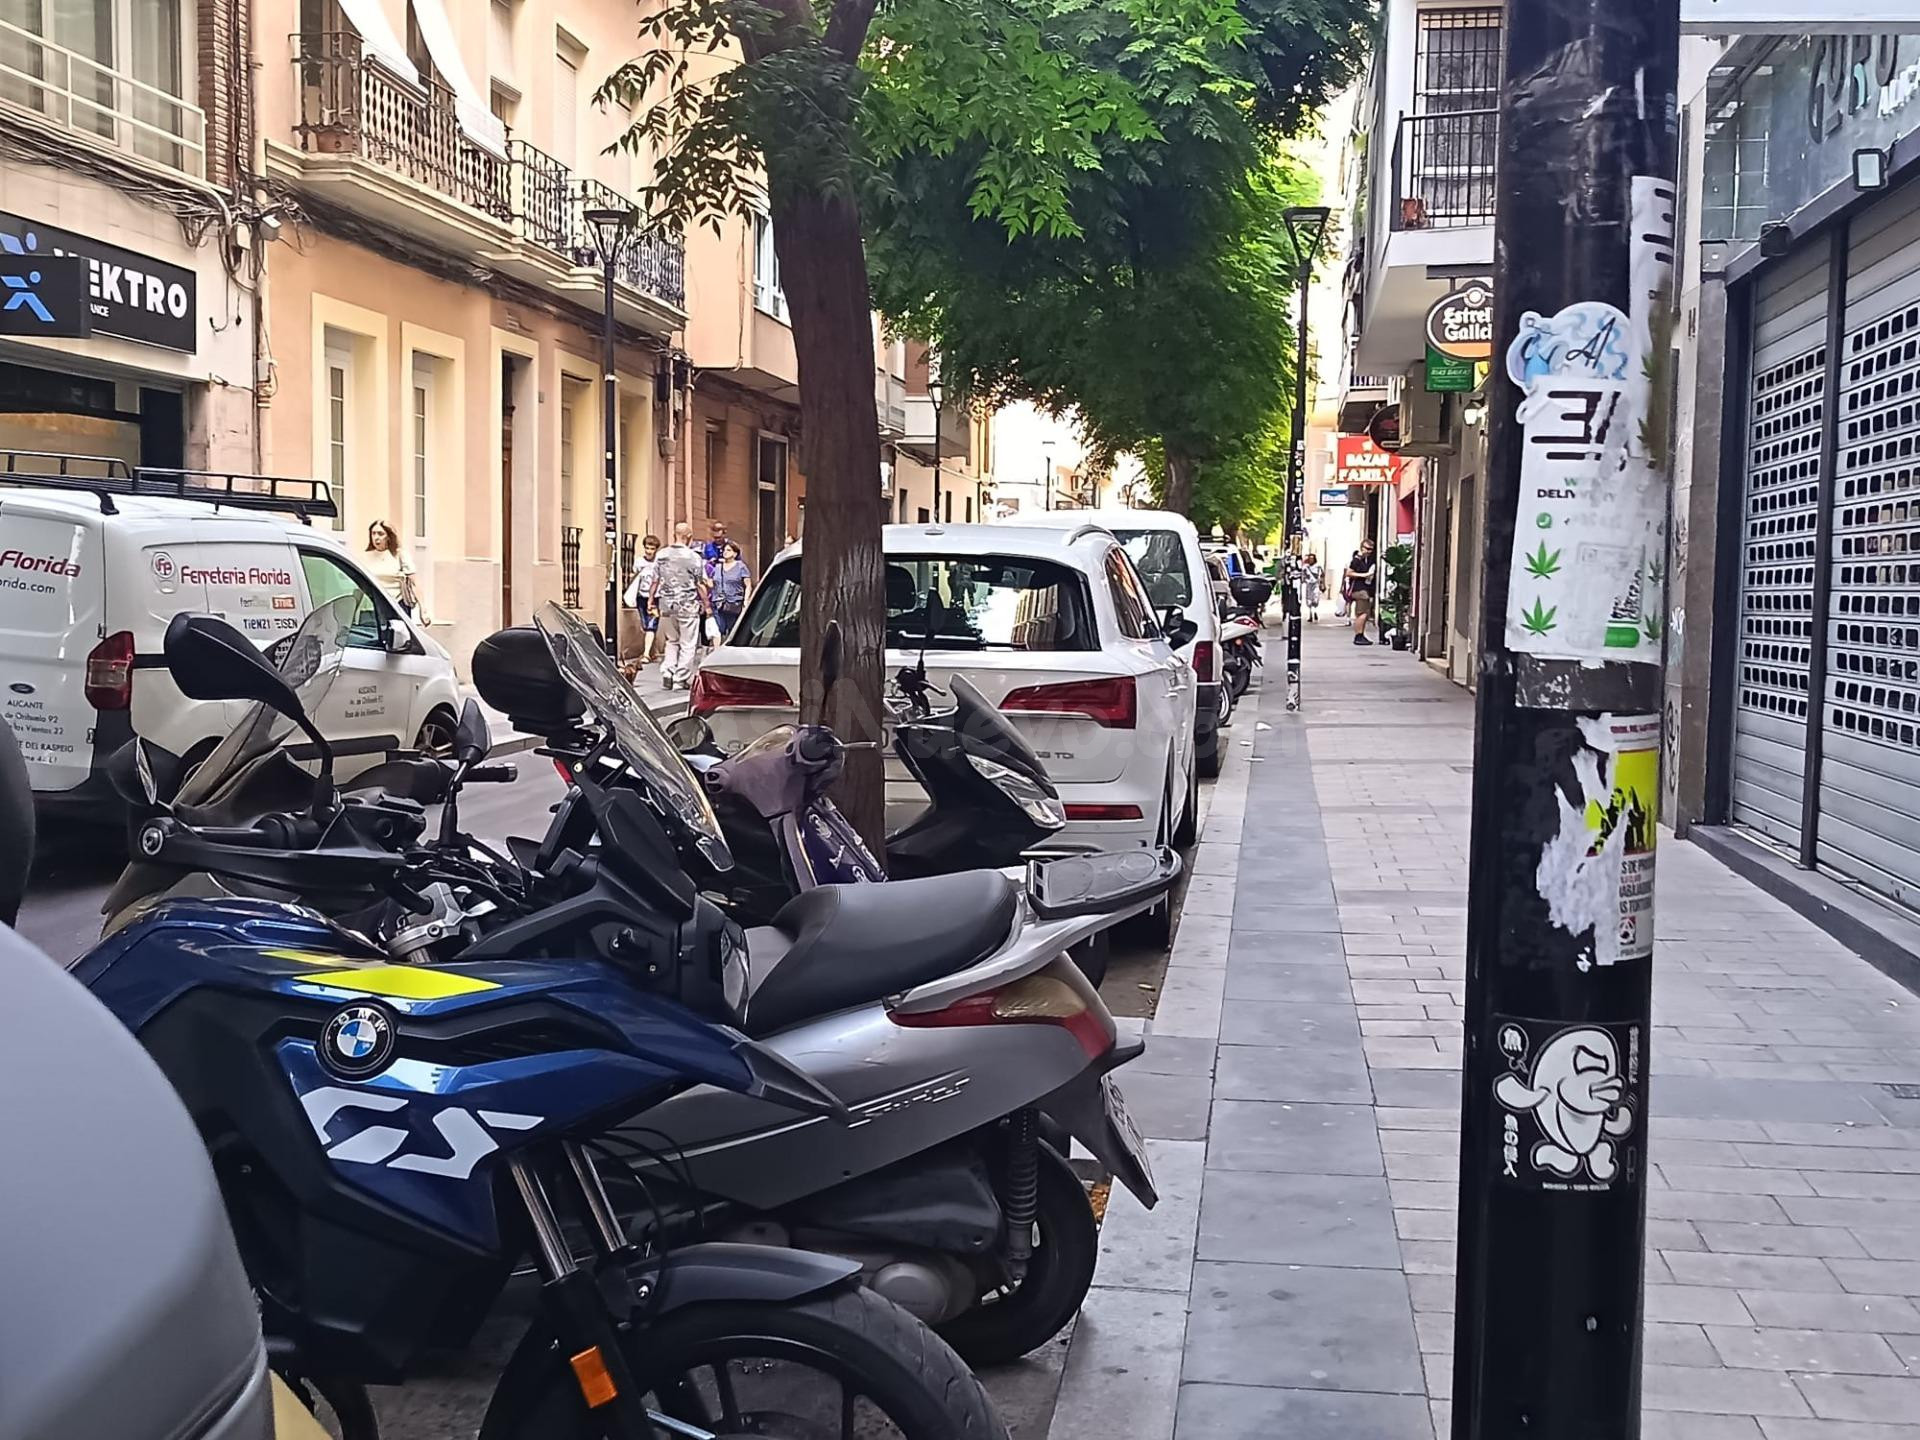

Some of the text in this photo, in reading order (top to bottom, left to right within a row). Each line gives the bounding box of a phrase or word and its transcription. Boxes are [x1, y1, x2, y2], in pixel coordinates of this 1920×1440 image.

[1345, 453, 1390, 467] BAZAR
[1338, 466, 1398, 482] FAMILY
[0, 550, 81, 578] Florida
[249, 567, 292, 586] Florida
[337, 1007, 387, 1033] BMW
[300, 1086, 545, 1180] GS
